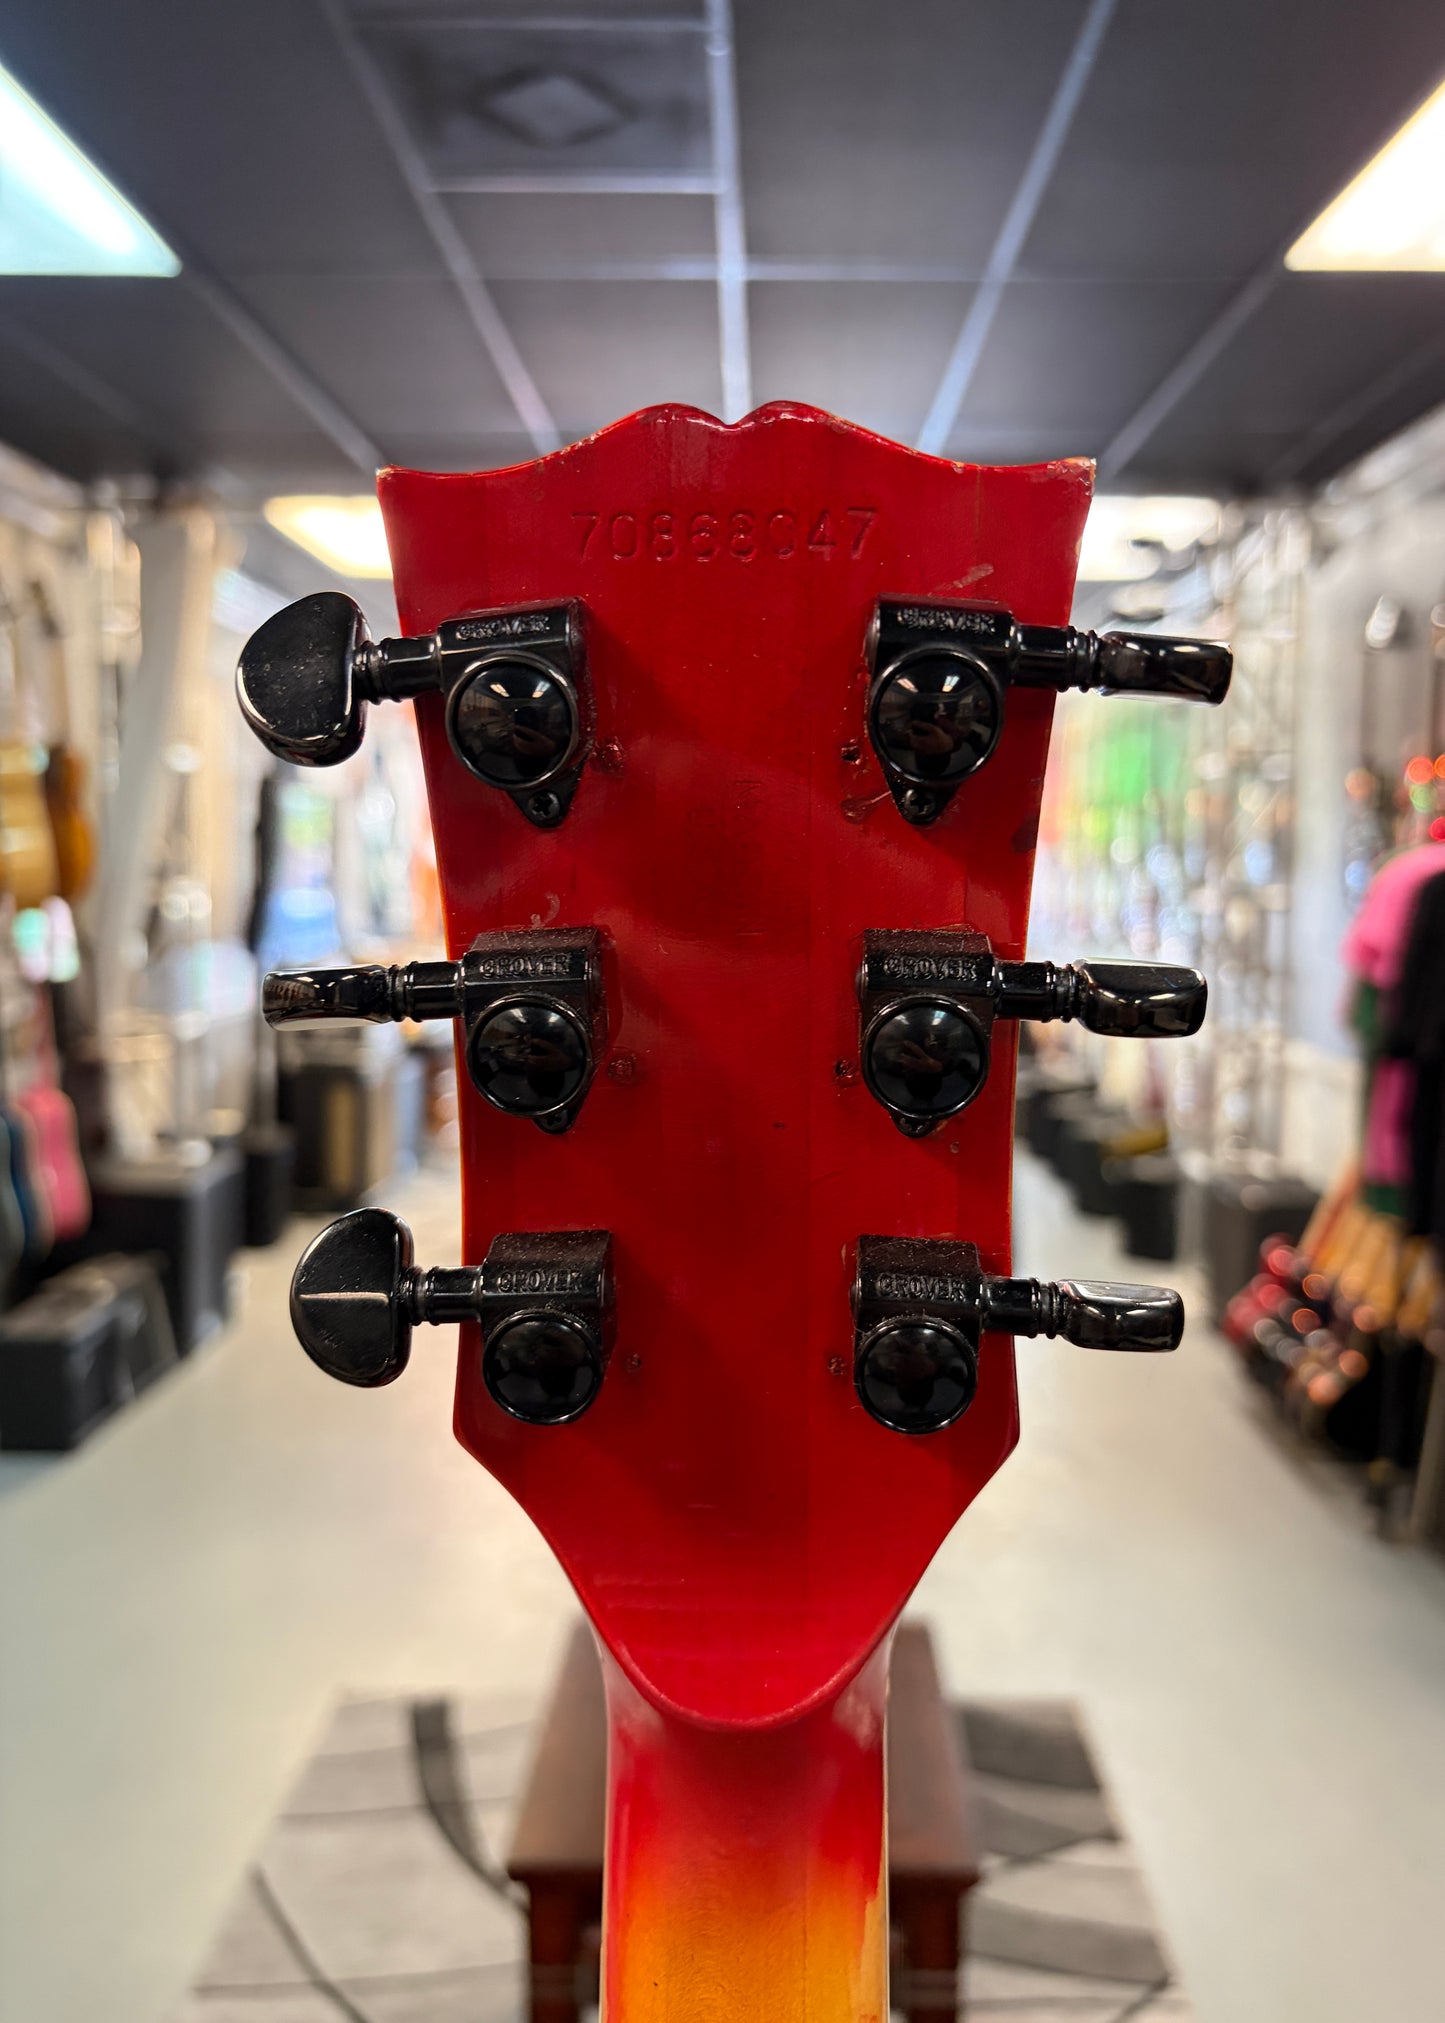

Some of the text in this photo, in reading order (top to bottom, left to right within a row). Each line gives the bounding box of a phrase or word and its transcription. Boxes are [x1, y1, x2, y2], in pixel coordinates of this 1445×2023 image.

[480, 952, 572, 979] GROVER
[497, 1268, 583, 1293] GROVER
[875, 1273, 966, 1302] GROVER
